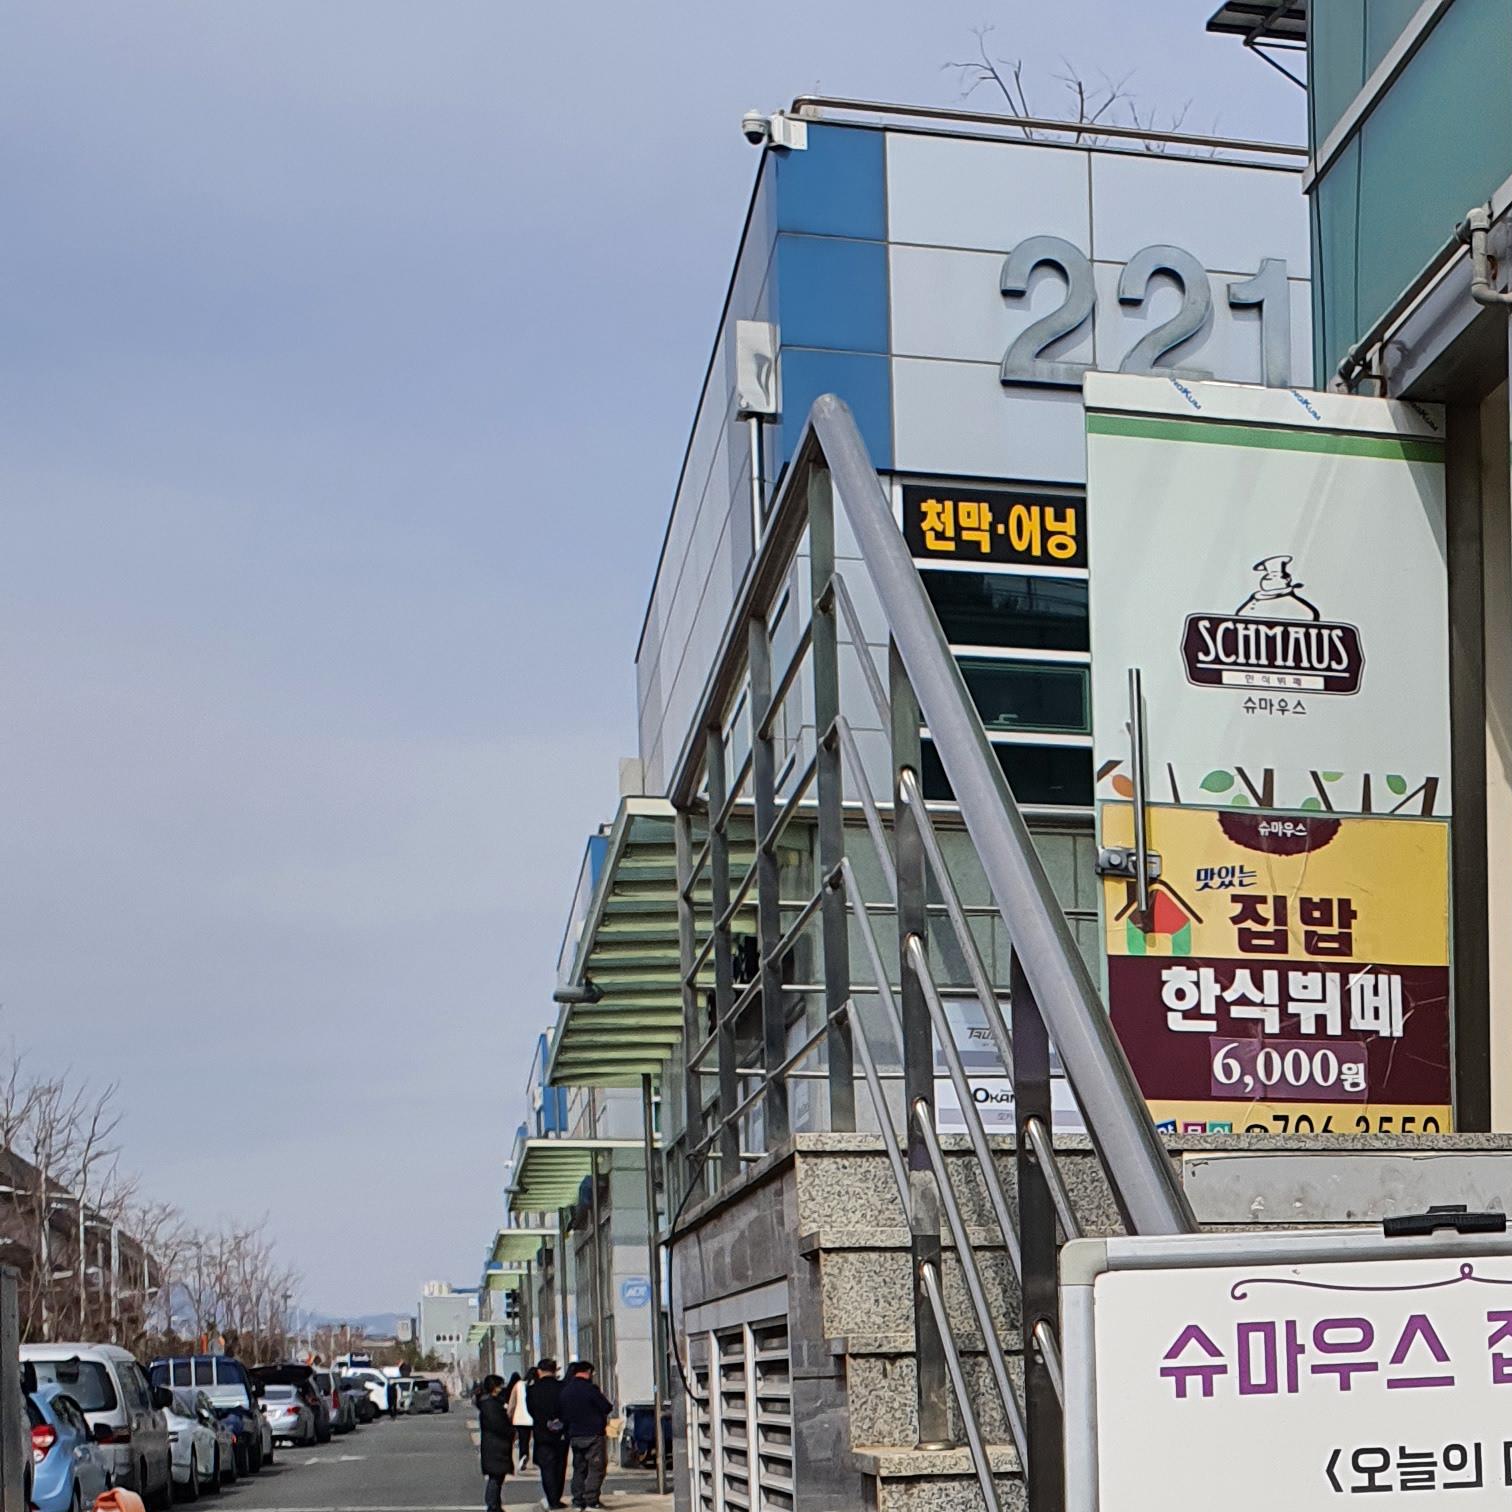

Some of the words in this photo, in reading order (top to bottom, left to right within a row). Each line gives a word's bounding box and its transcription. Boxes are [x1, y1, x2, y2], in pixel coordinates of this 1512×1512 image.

[1000, 235, 1290, 391] 221
[1197, 619, 1350, 671] SCHMAUS
[1242, 696, 1307, 716] 슈마우스
[1258, 819, 1308, 838] 슈마우스
[1195, 864, 1258, 892] 맛있는
[1229, 892, 1358, 958] 집밥
[1211, 1043, 1367, 1098] 6,000원
[1158, 1314, 1456, 1399] 슈마우스
